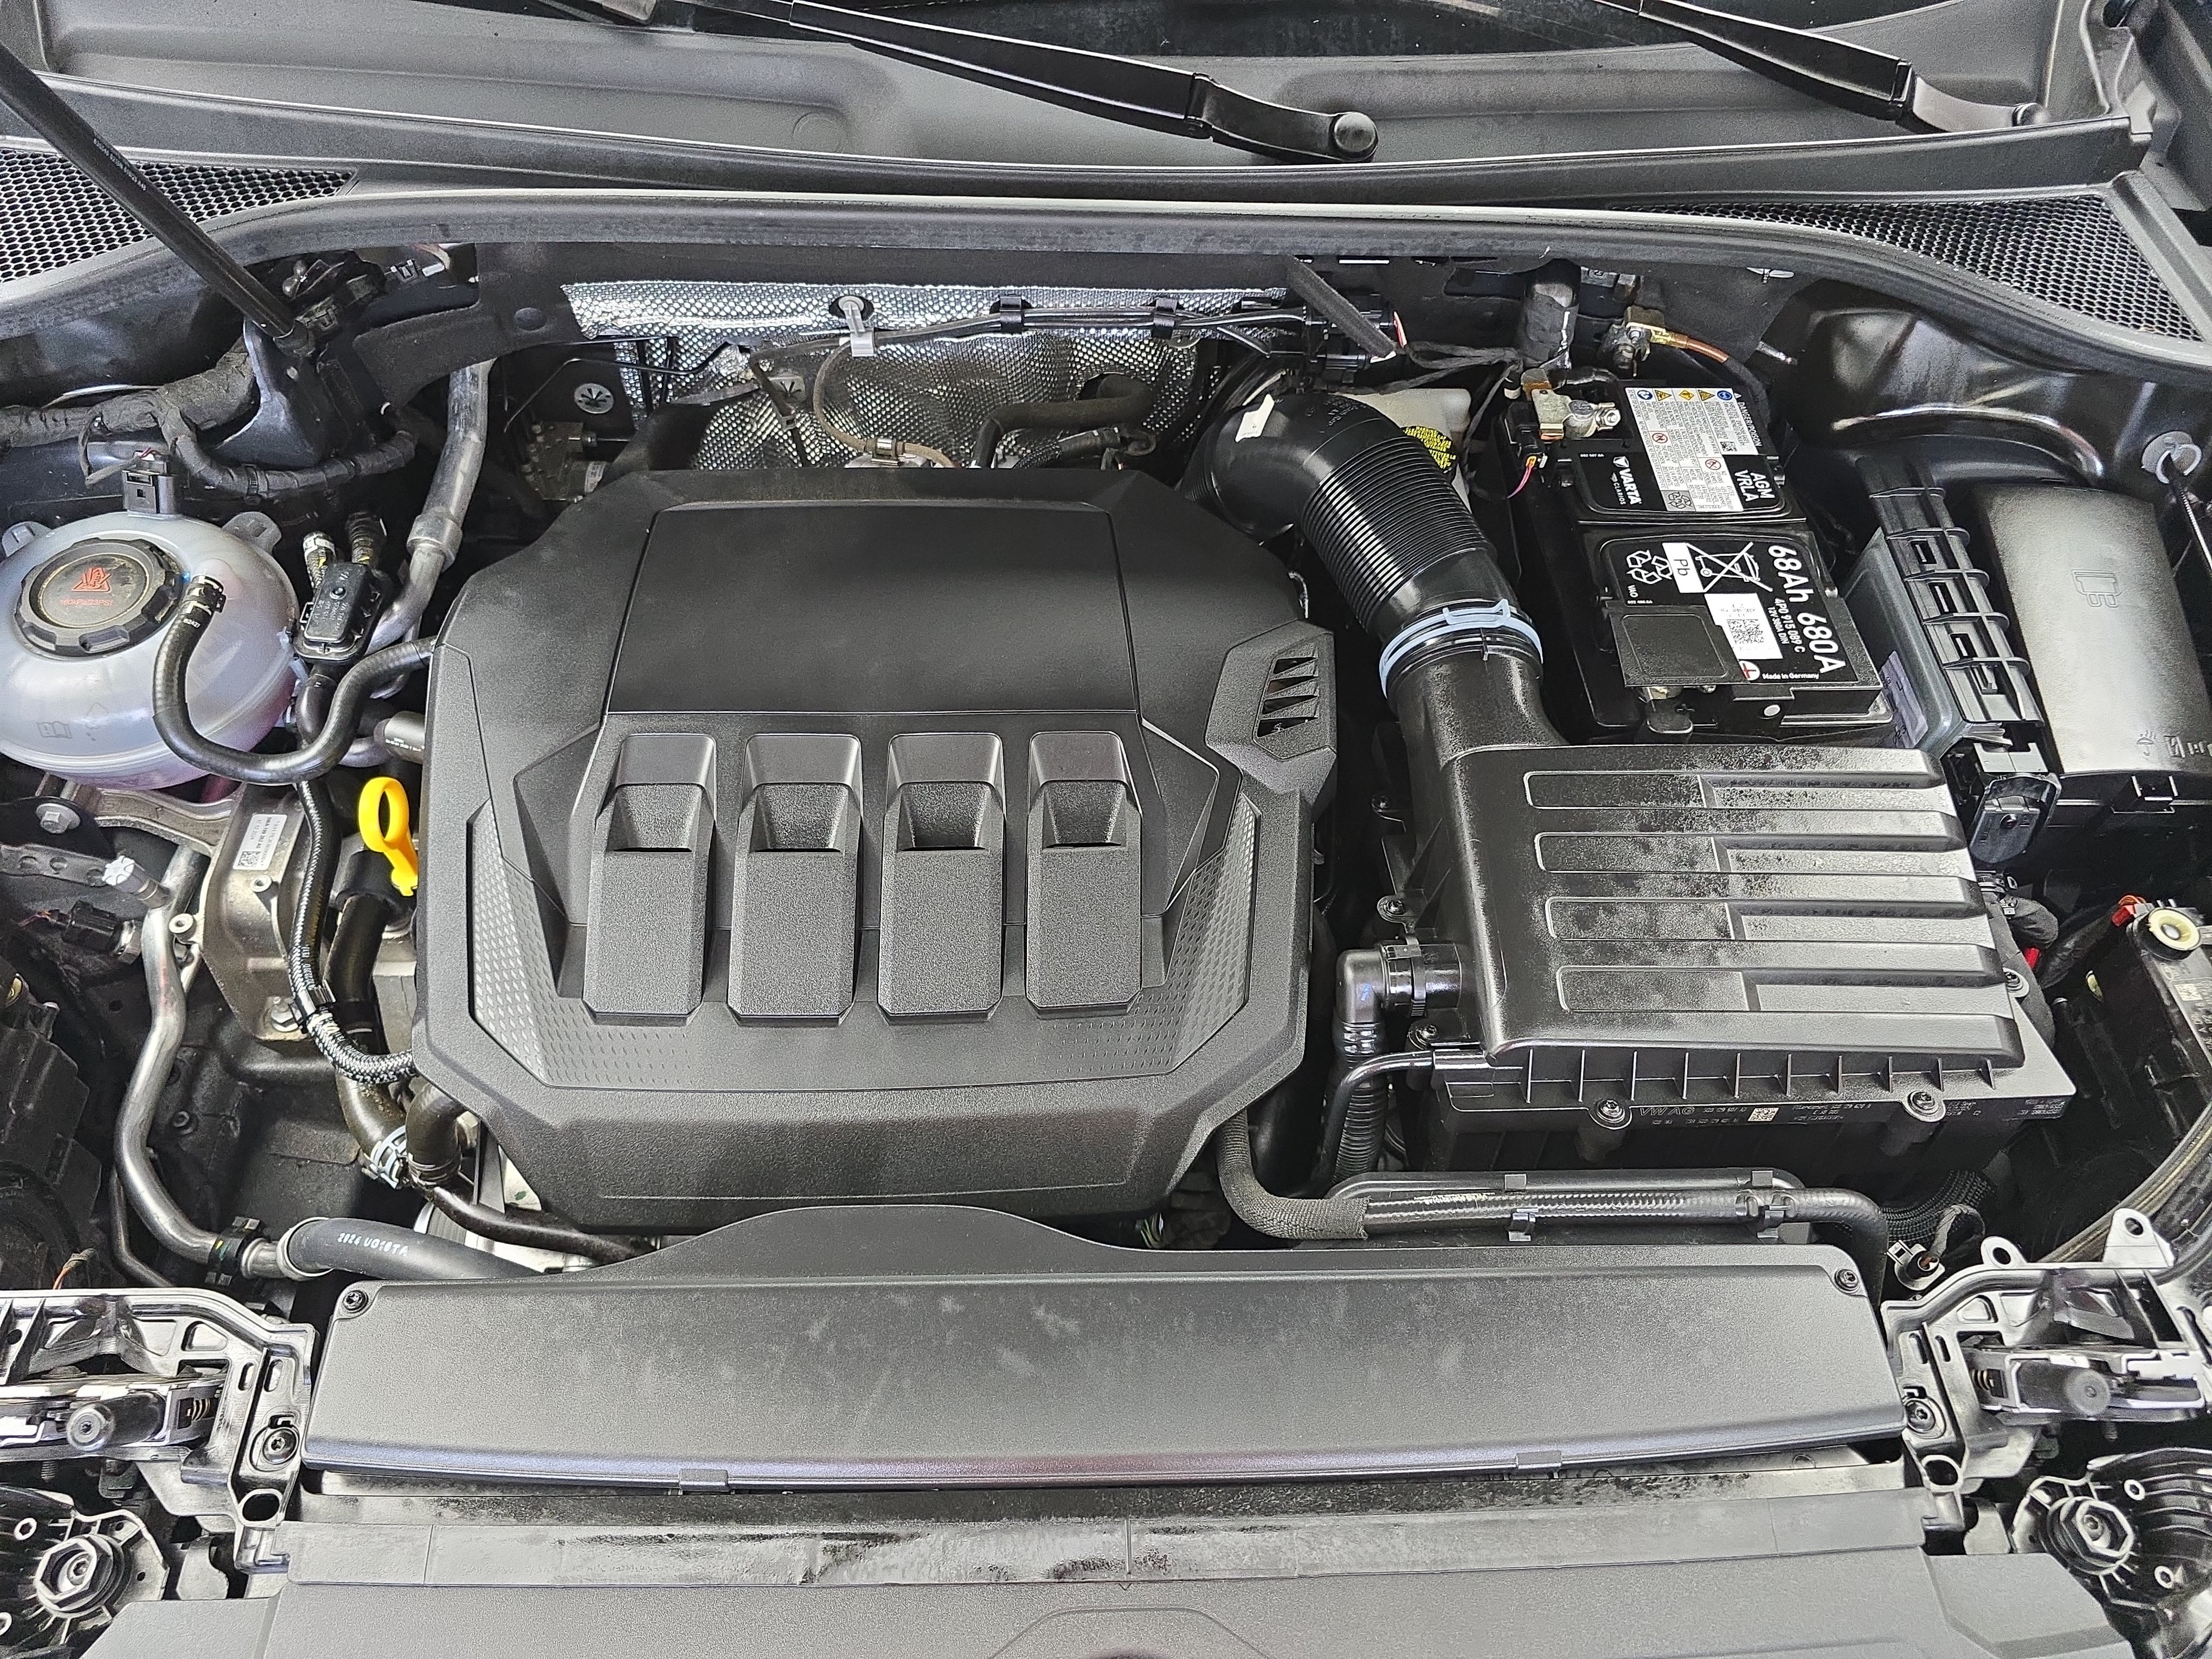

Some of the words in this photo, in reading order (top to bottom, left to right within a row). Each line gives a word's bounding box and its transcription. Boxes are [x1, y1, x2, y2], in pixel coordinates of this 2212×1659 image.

[1738, 402, 1762, 446] DANGER/POISON
[1613, 483, 1626, 505] CLARIOS
[1619, 468, 1642, 505] VARTA
[1735, 470, 1759, 501] VRLA
[1750, 472, 1775, 498] AGM
[1673, 559, 1690, 576] Pb
[1769, 545, 1814, 602] 68Ah
[1797, 613, 1846, 673] 680A
[1783, 615, 1796, 629] 915
[1767, 606, 1778, 619] 12V
[1779, 633, 1790, 645] DIN
[1788, 630, 1802, 645] 089
[1639, 1107, 1668, 1116] VW
[1668, 1106, 1695, 1115] AG
